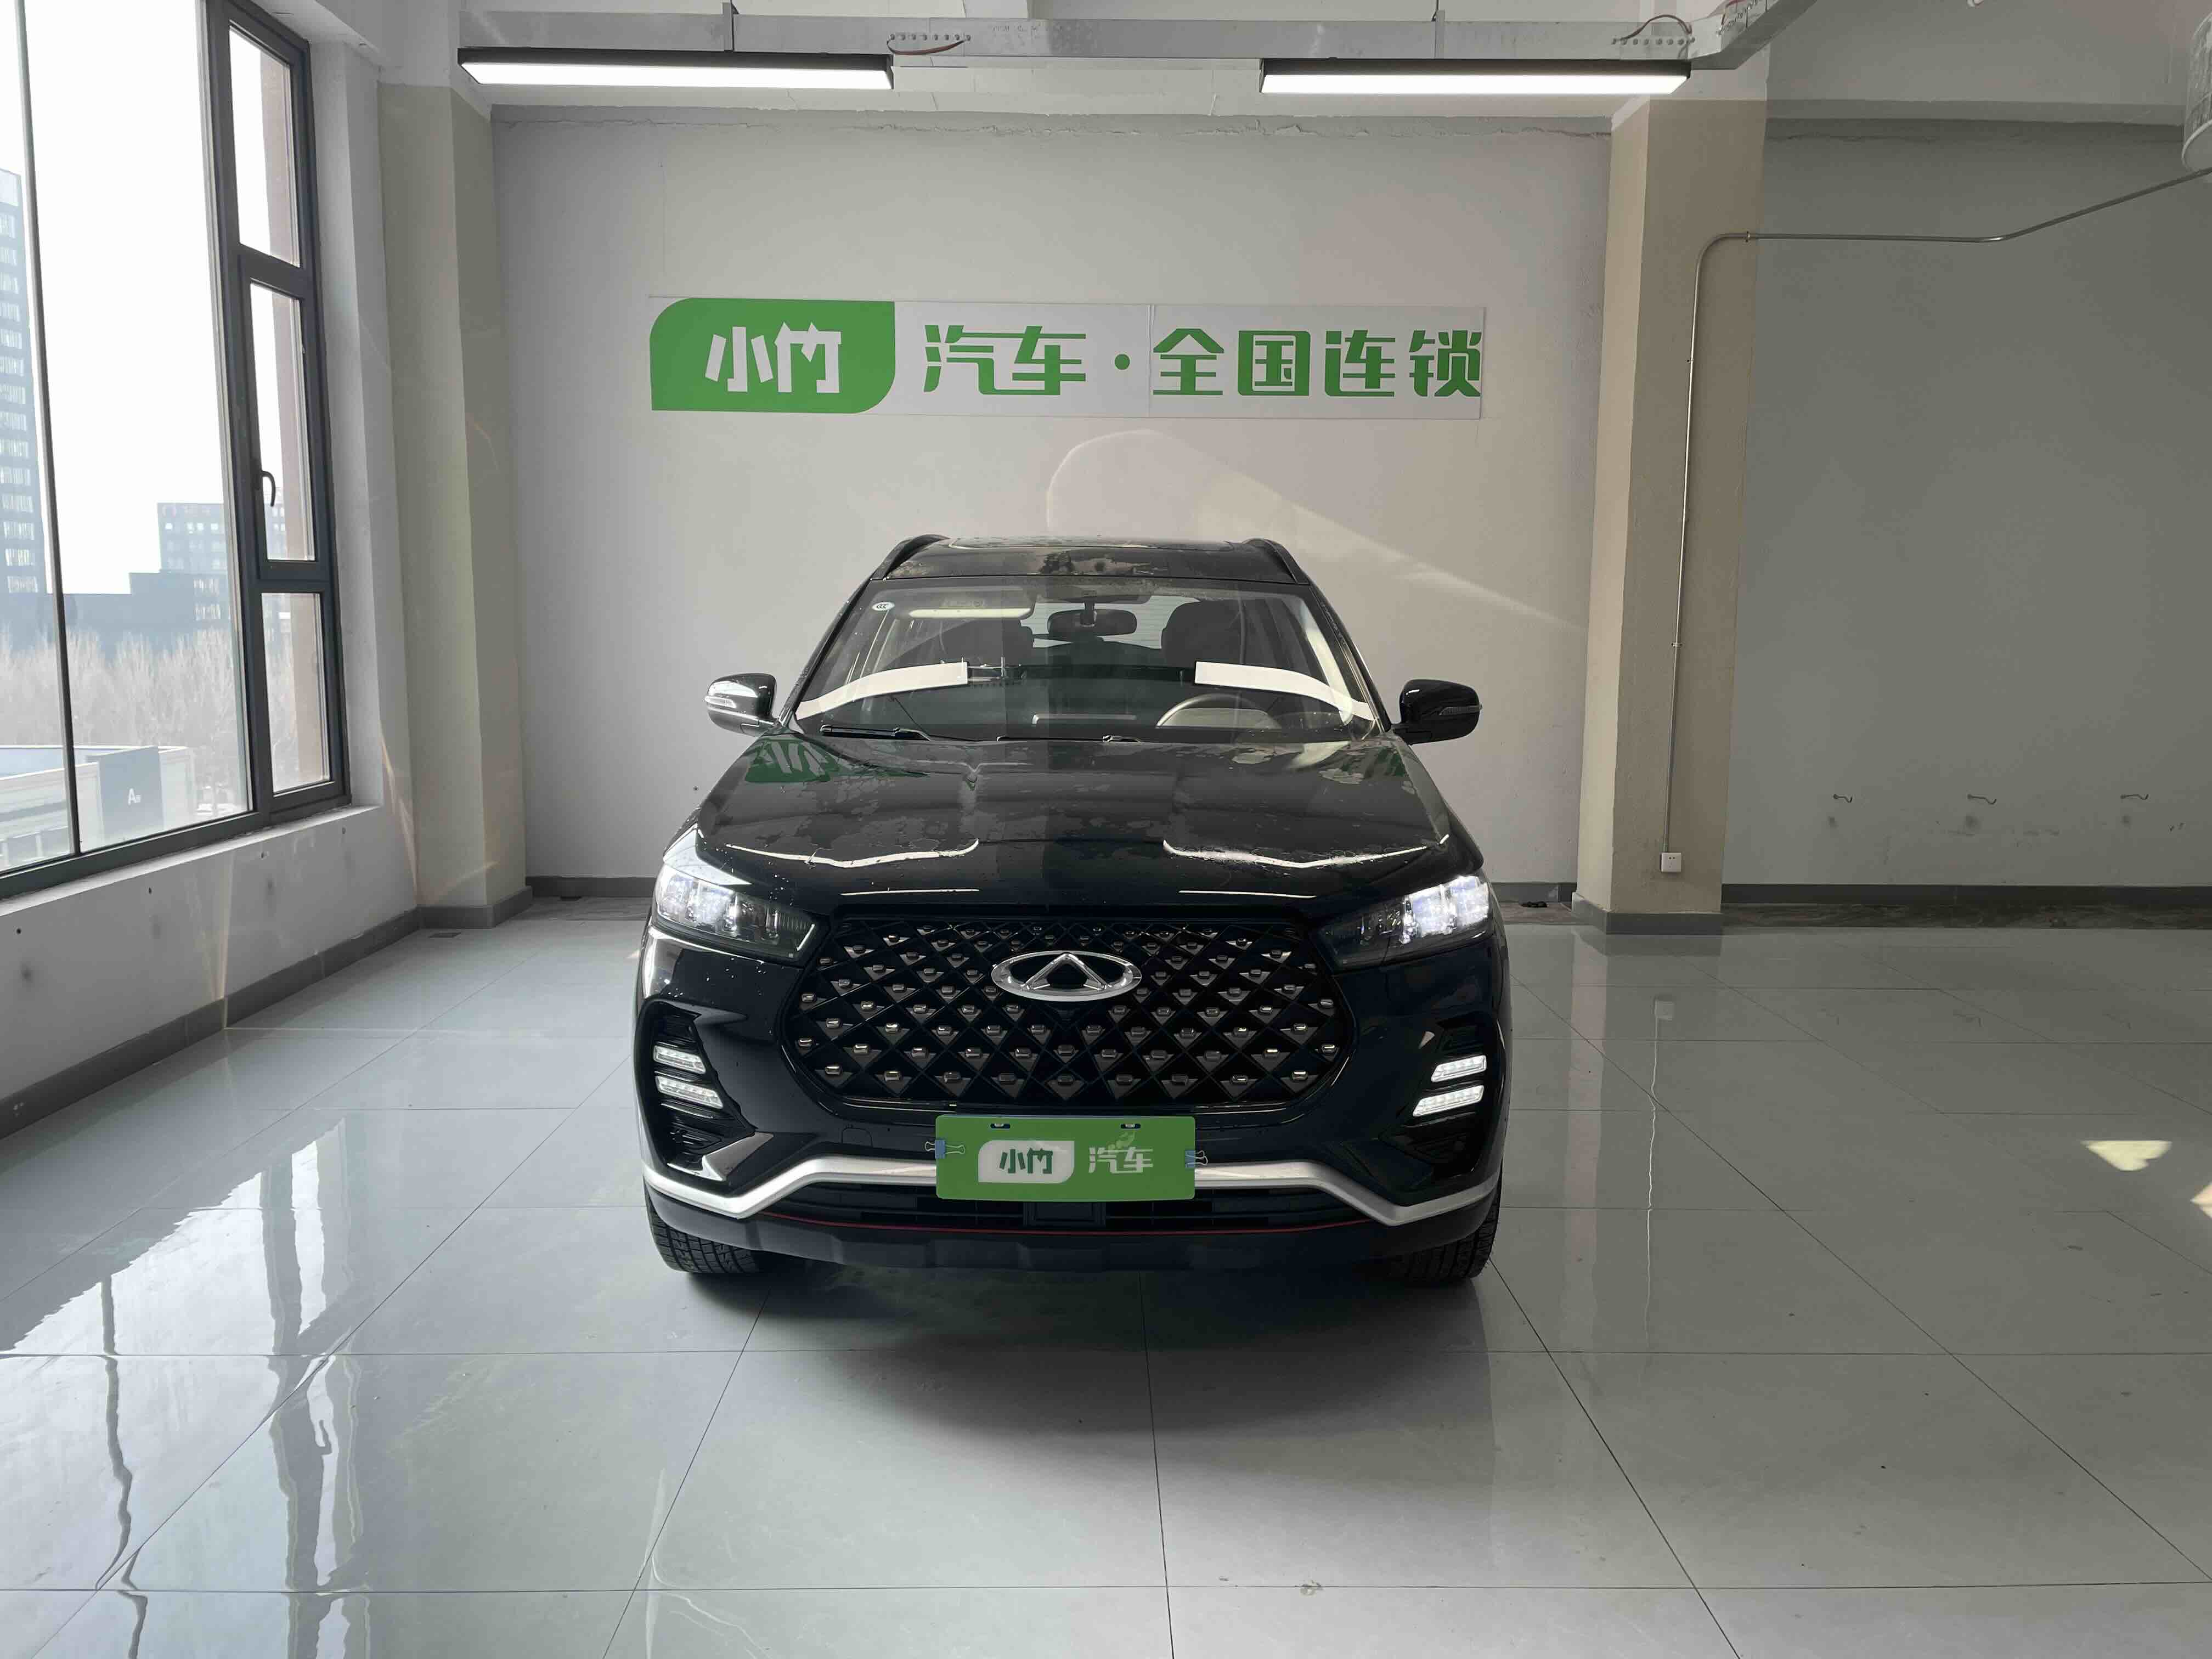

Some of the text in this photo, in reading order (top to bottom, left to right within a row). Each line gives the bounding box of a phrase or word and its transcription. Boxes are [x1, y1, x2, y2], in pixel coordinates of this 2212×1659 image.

[704, 321, 842, 394] 小竹
[998, 1147, 1154, 1175] 小竹 汽车
